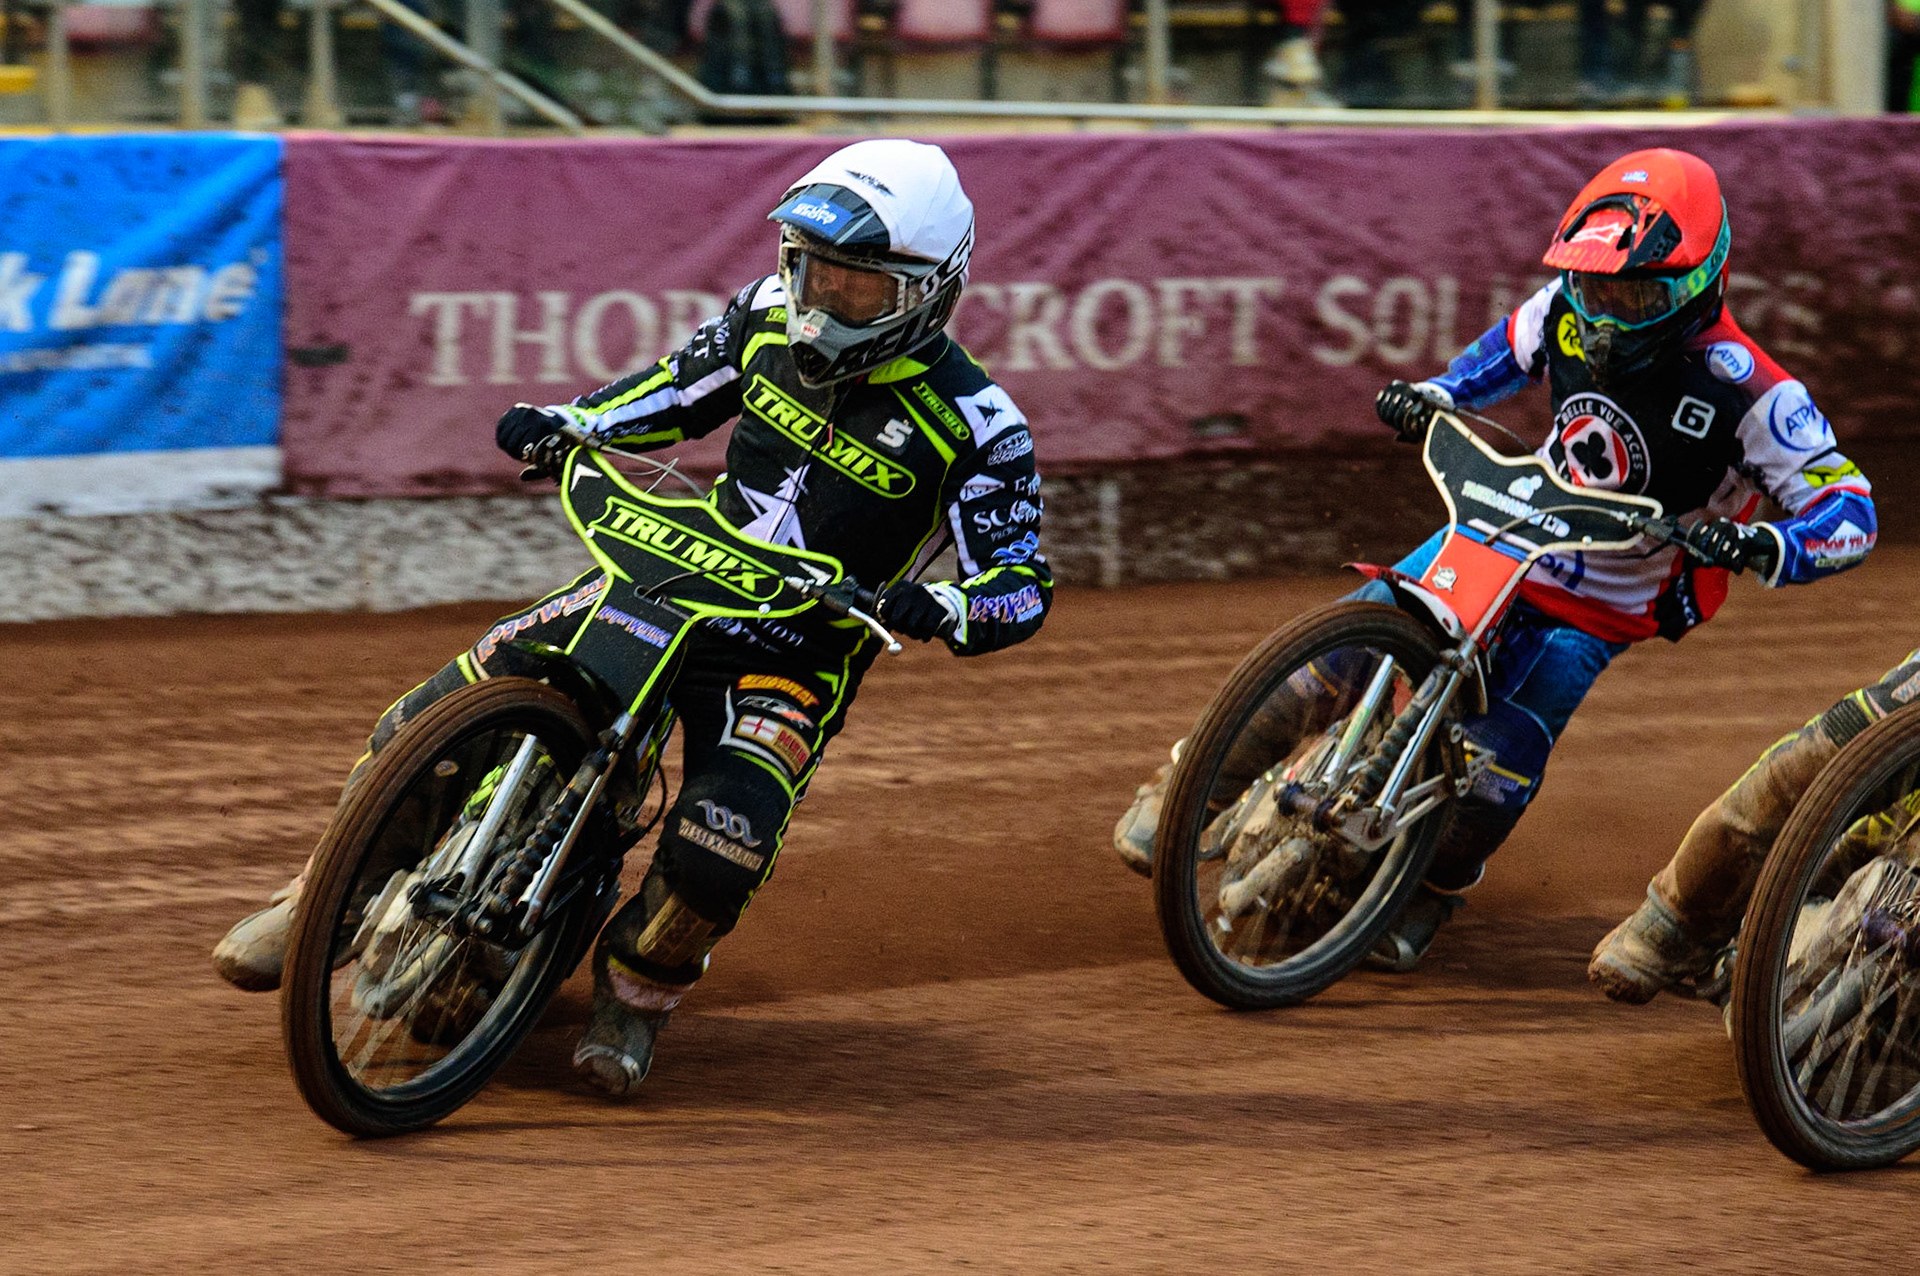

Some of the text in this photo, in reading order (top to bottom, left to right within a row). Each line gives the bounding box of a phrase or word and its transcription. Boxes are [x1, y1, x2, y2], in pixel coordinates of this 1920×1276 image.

[753, 386, 904, 491] TRU MIX
[1561, 400, 1644, 471] BELLE VUE ACES
[610, 507, 770, 593] TRU MIX
[477, 609, 541, 664] Roger
[539, 573, 607, 624] Warne
